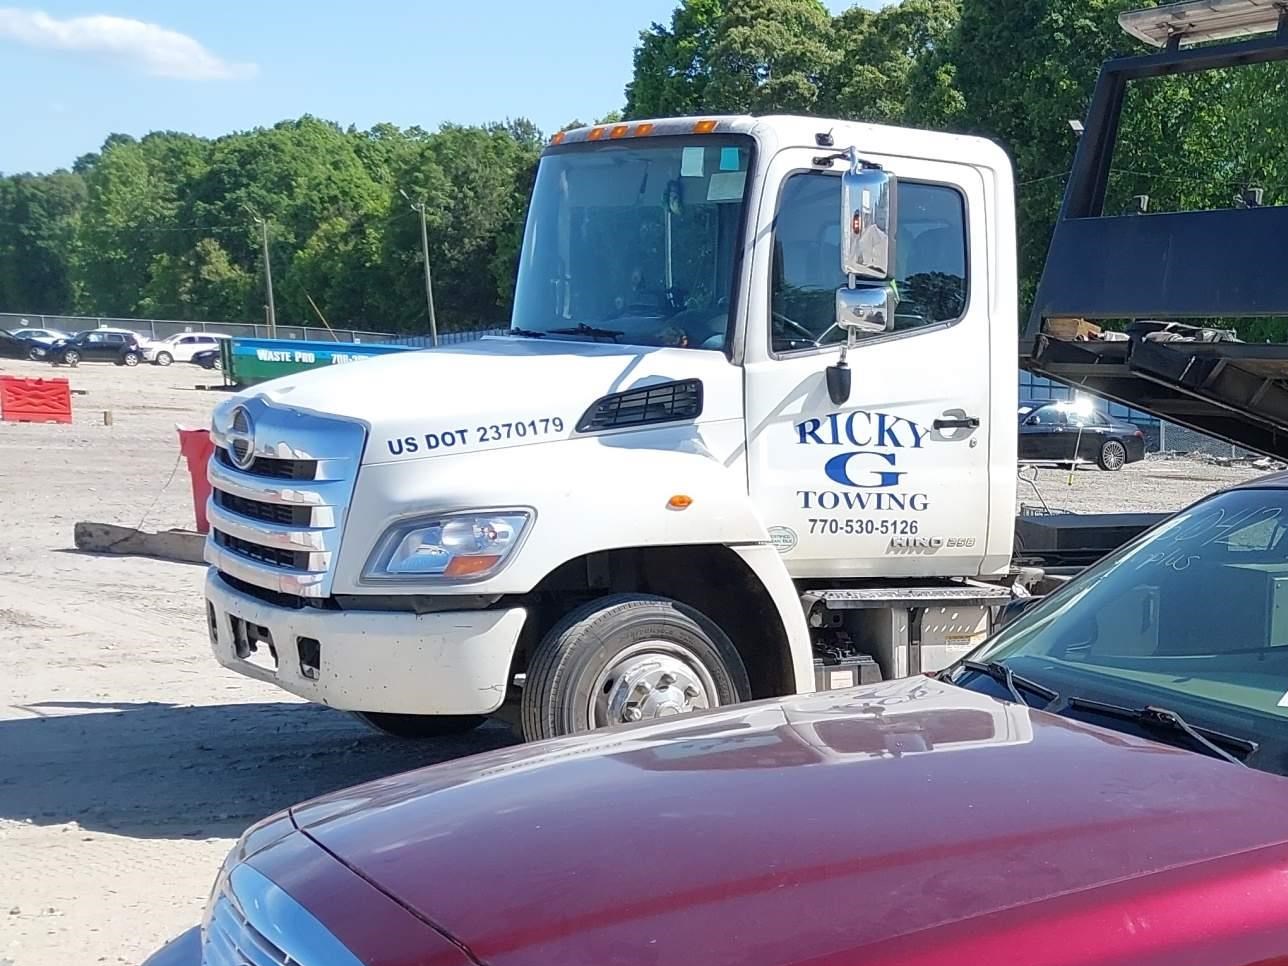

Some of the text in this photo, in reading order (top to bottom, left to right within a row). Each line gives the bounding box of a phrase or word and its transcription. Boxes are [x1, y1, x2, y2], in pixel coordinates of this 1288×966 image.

[256, 350, 292, 362] WASTE
[294, 351, 315, 363] PRO
[387, 416, 565, 456] US DOT 2370179
[796, 410, 932, 449] RICKY
[824, 451, 908, 488] G
[796, 490, 930, 512] TOWING
[808, 518, 919, 535] 770-530-5126
[889, 536, 944, 549] HINO
